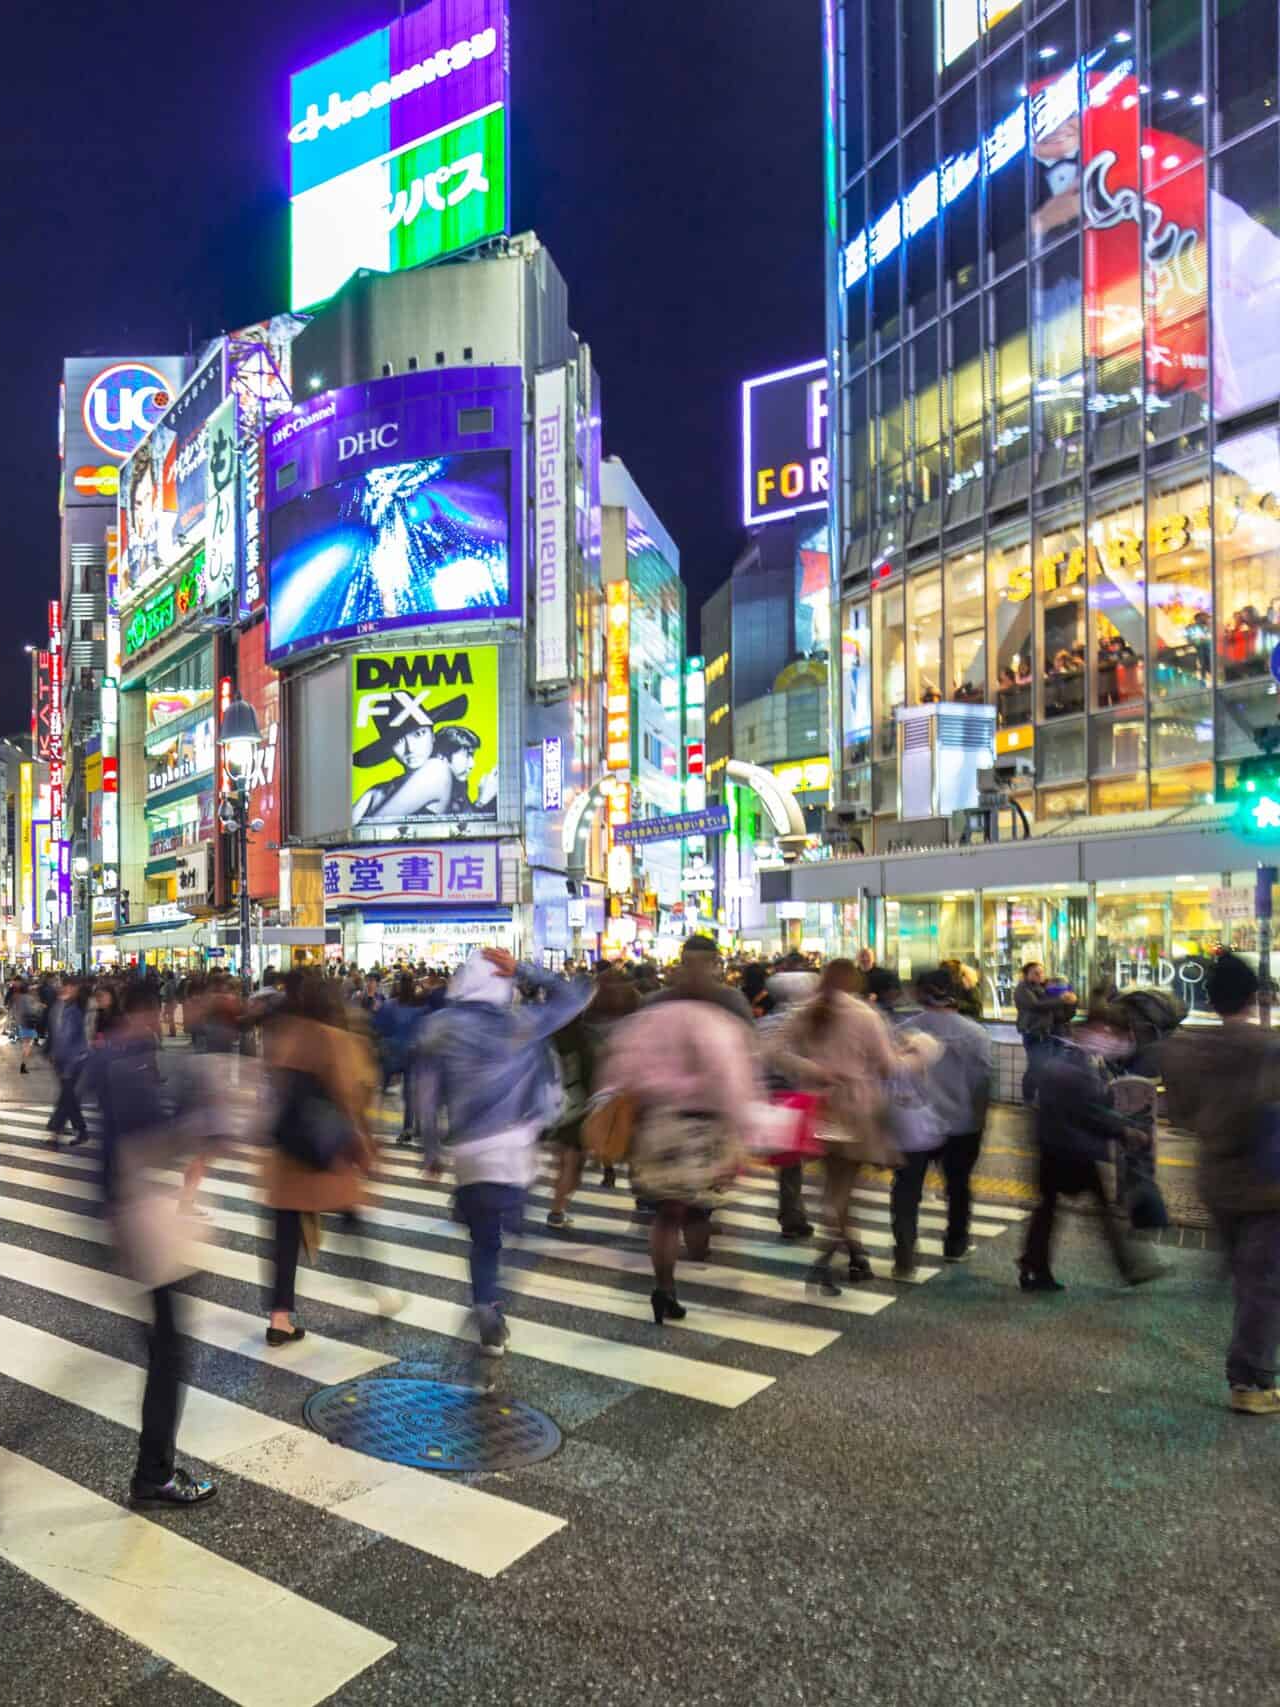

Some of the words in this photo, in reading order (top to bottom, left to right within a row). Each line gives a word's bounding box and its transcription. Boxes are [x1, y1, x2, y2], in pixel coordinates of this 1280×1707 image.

[338, 423, 400, 462] DHC
[209, 428, 235, 588] もんじゃ
[539, 520, 558, 603] neon
[356, 652, 473, 690] DMM
[356, 690, 433, 728] FX
